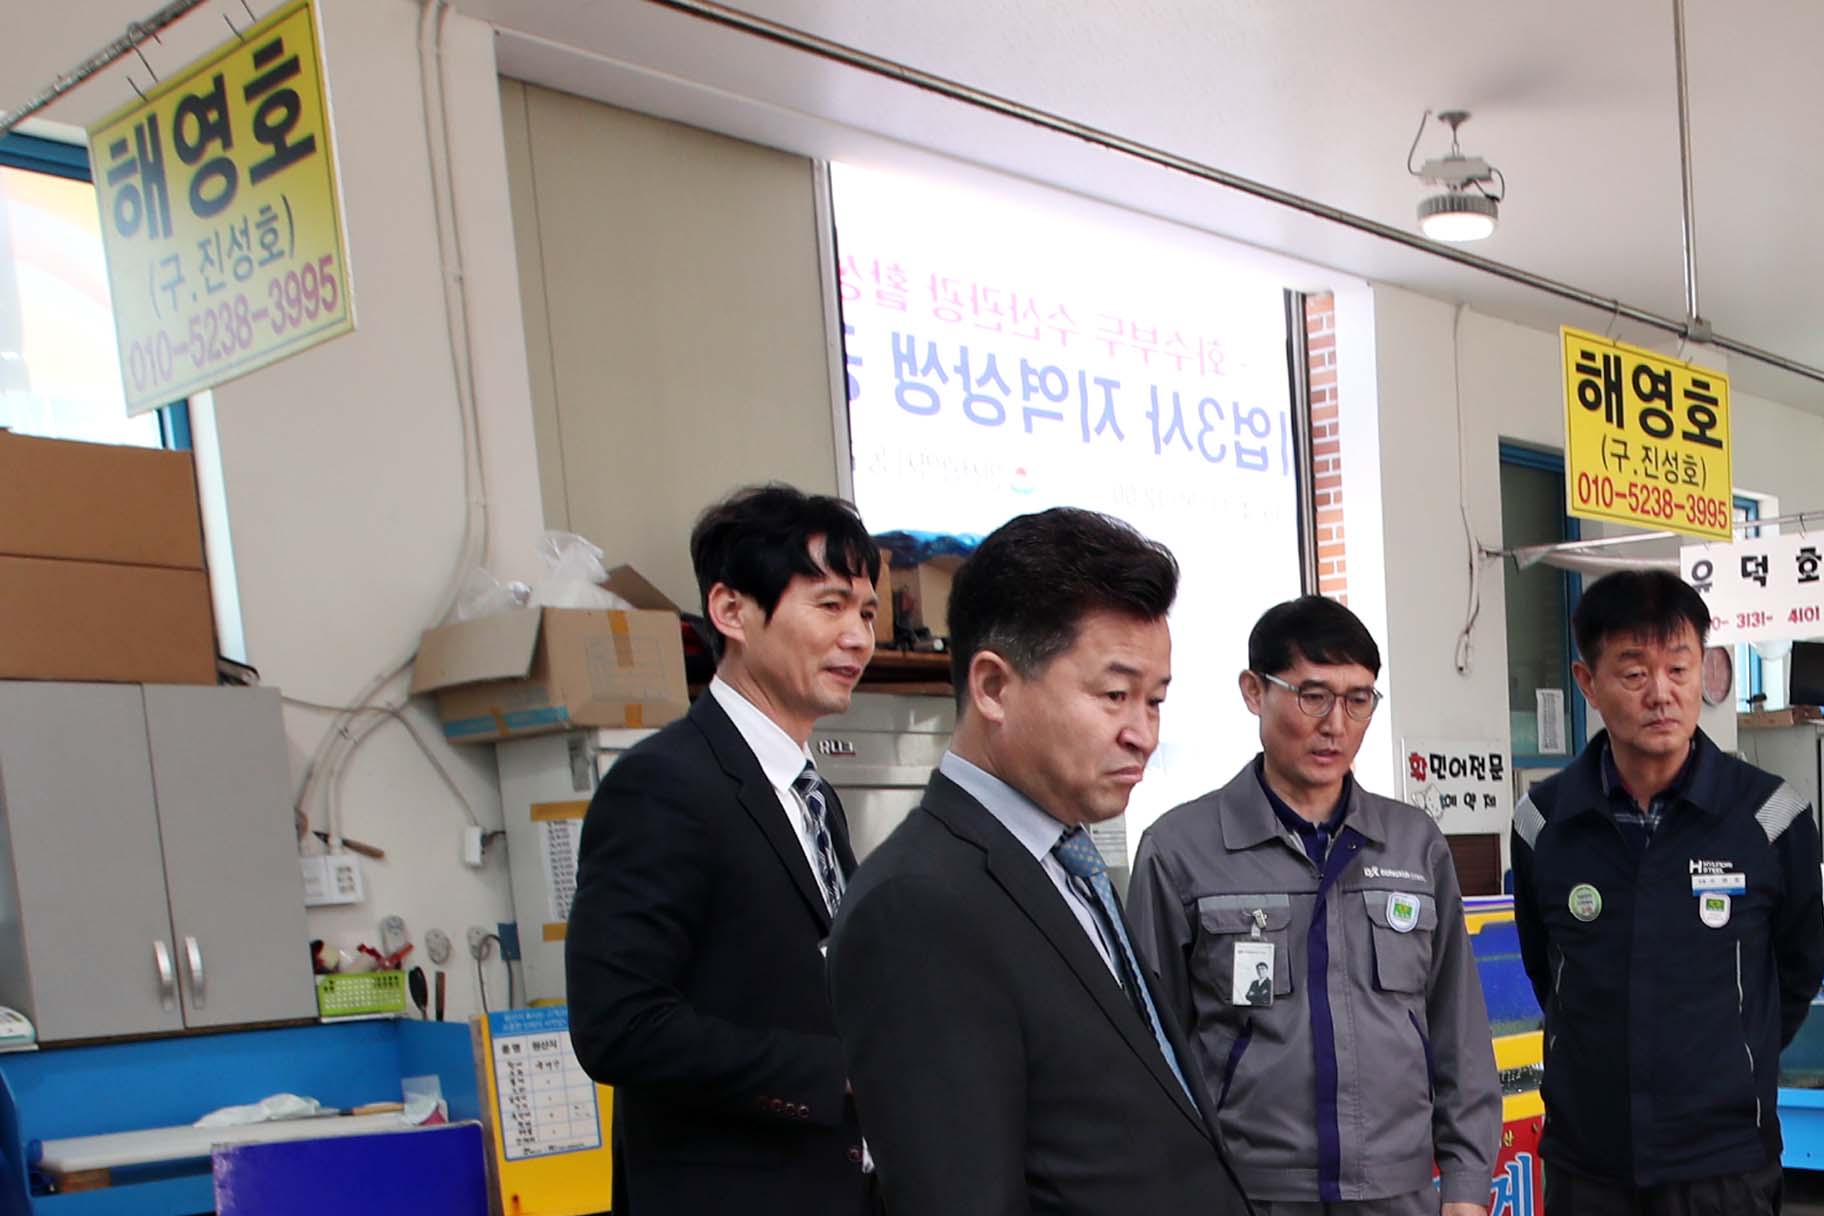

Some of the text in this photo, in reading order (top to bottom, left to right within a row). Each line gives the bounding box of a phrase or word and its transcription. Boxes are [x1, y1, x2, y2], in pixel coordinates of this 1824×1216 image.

[106, 35, 318, 240] 해영호
[129, 254, 339, 394] 010-5238-3995
[1575, 349, 1724, 449] 해영호
[1578, 471, 1728, 529] 010-5238-3995
[1601, 434, 1707, 491] (구.진성호)
